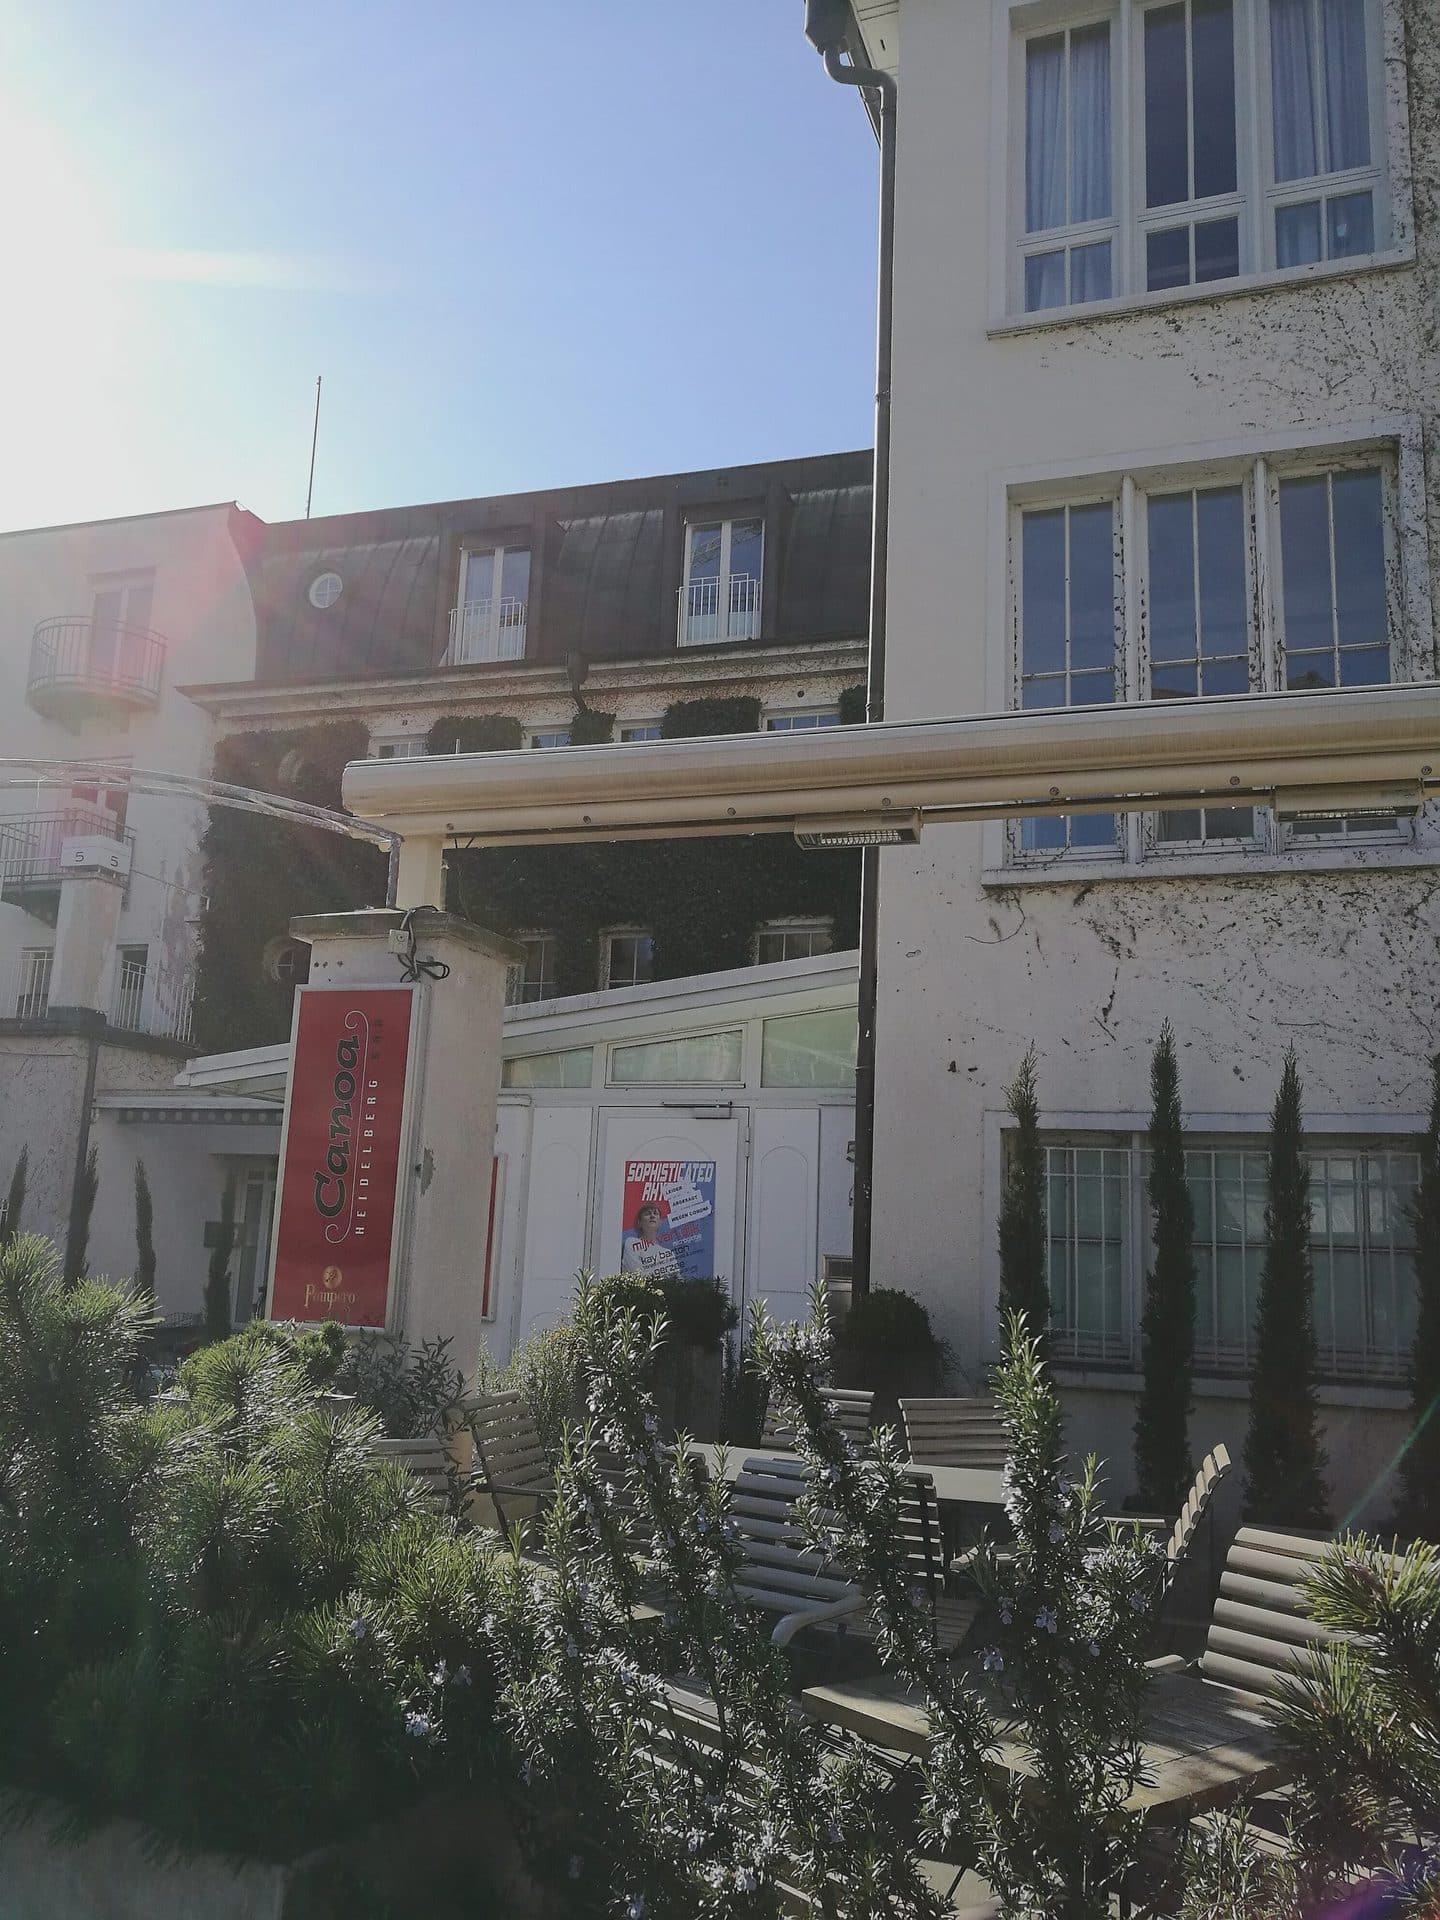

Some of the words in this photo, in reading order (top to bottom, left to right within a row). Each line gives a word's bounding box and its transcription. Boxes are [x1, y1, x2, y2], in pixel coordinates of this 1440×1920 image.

[75, 851, 84, 862] 5
[110, 855, 119, 867] 5
[313, 1035, 360, 1218] Canoa
[355, 1080, 378, 1235] HEIDELBERG
[627, 1162, 714, 1183] SOPHISTICATED
[640, 1255, 658, 1266] kay
